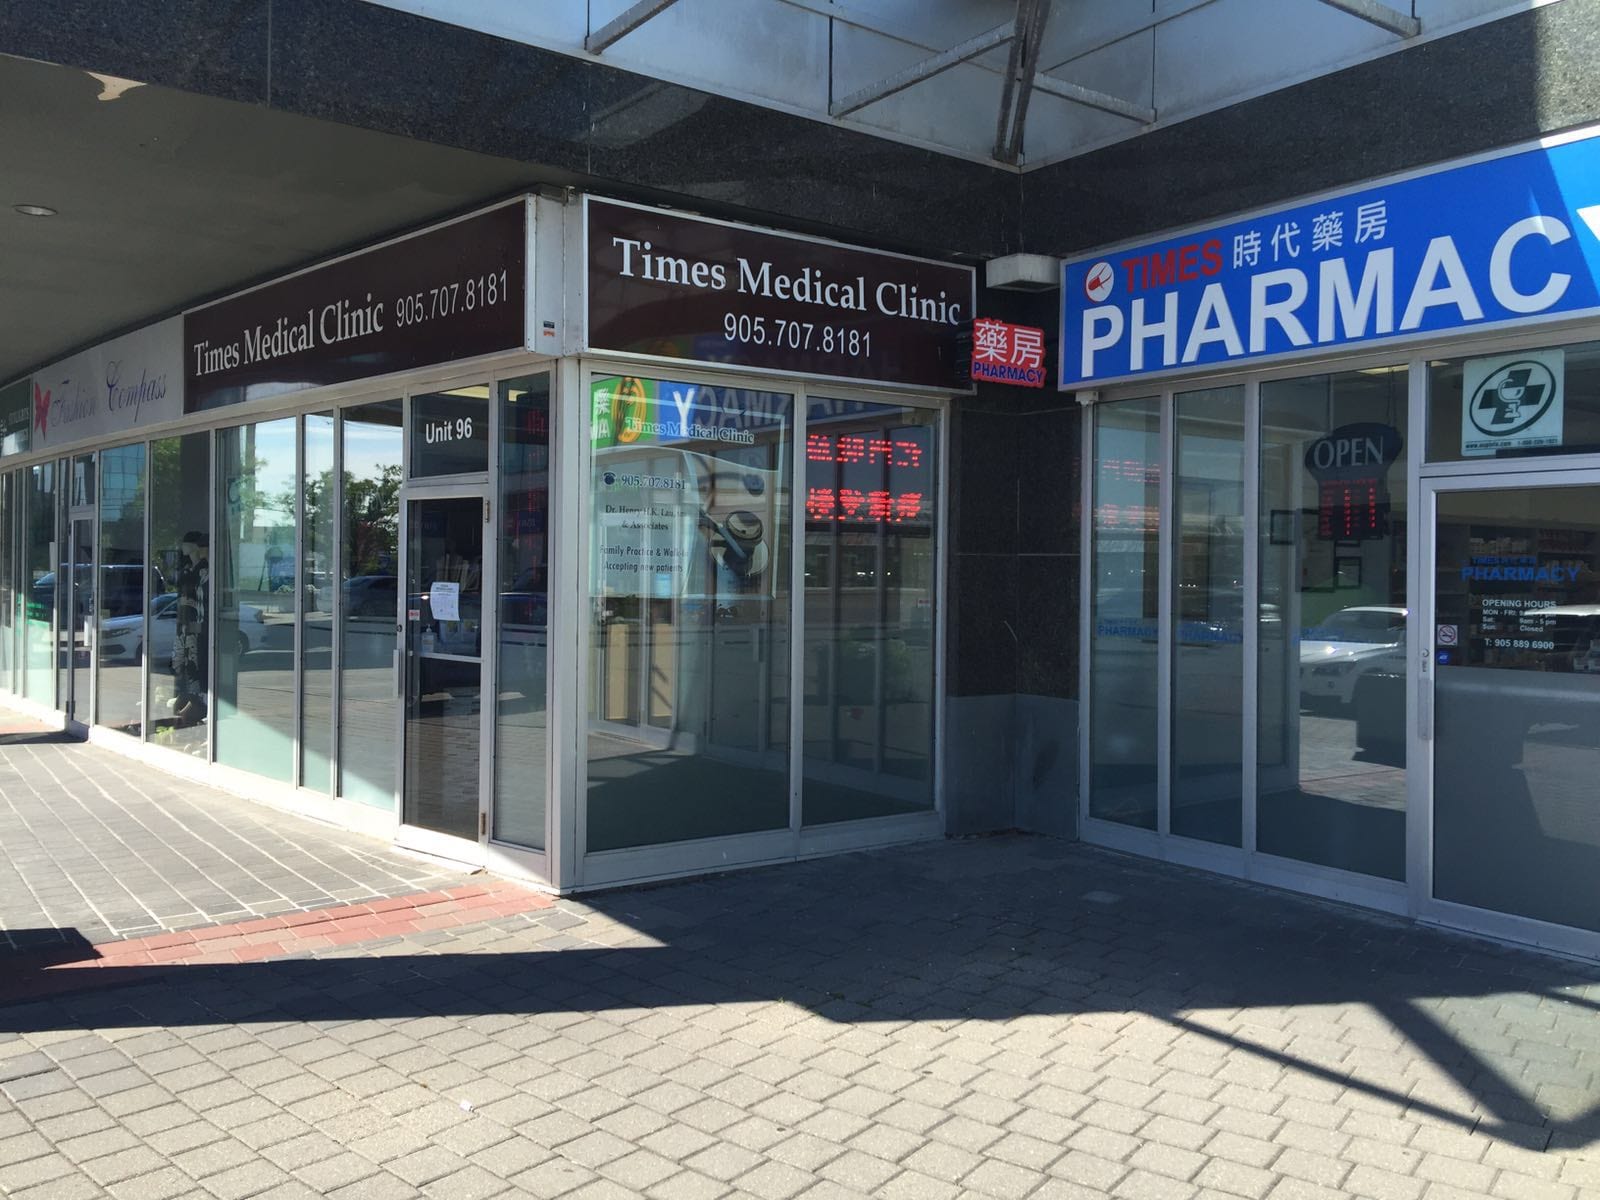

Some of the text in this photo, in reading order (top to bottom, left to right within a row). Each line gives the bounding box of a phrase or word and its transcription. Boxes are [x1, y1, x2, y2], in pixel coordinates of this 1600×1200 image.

[1233, 199, 1388, 270] 時代藥房
[612, 236, 961, 326] Times Medical Clinic
[1121, 239, 1223, 293] TIMES
[193, 269, 507, 377] Times Medical Clinic 905.707.8181
[724, 312, 870, 358] 905.707.8181
[975, 321, 1043, 368] 藥房
[973, 361, 1043, 384] PHARMACY
[106, 360, 167, 423] Compass
[425, 416, 473, 444] Unit 96
[624, 416, 667, 436] Times
[719, 427, 755, 445] Clinic
[1313, 435, 1384, 469] OPEN
[621, 475, 686, 490] 905.707.8181
[605, 504, 617, 513] Dr.
[1462, 566, 1580, 582] PHARMACY
[1482, 599, 1557, 609] OPENING HOURS
[1494, 639, 1511, 647] 905
[1513, 640, 1529, 648] 889
[1532, 641, 1555, 649] 6900
